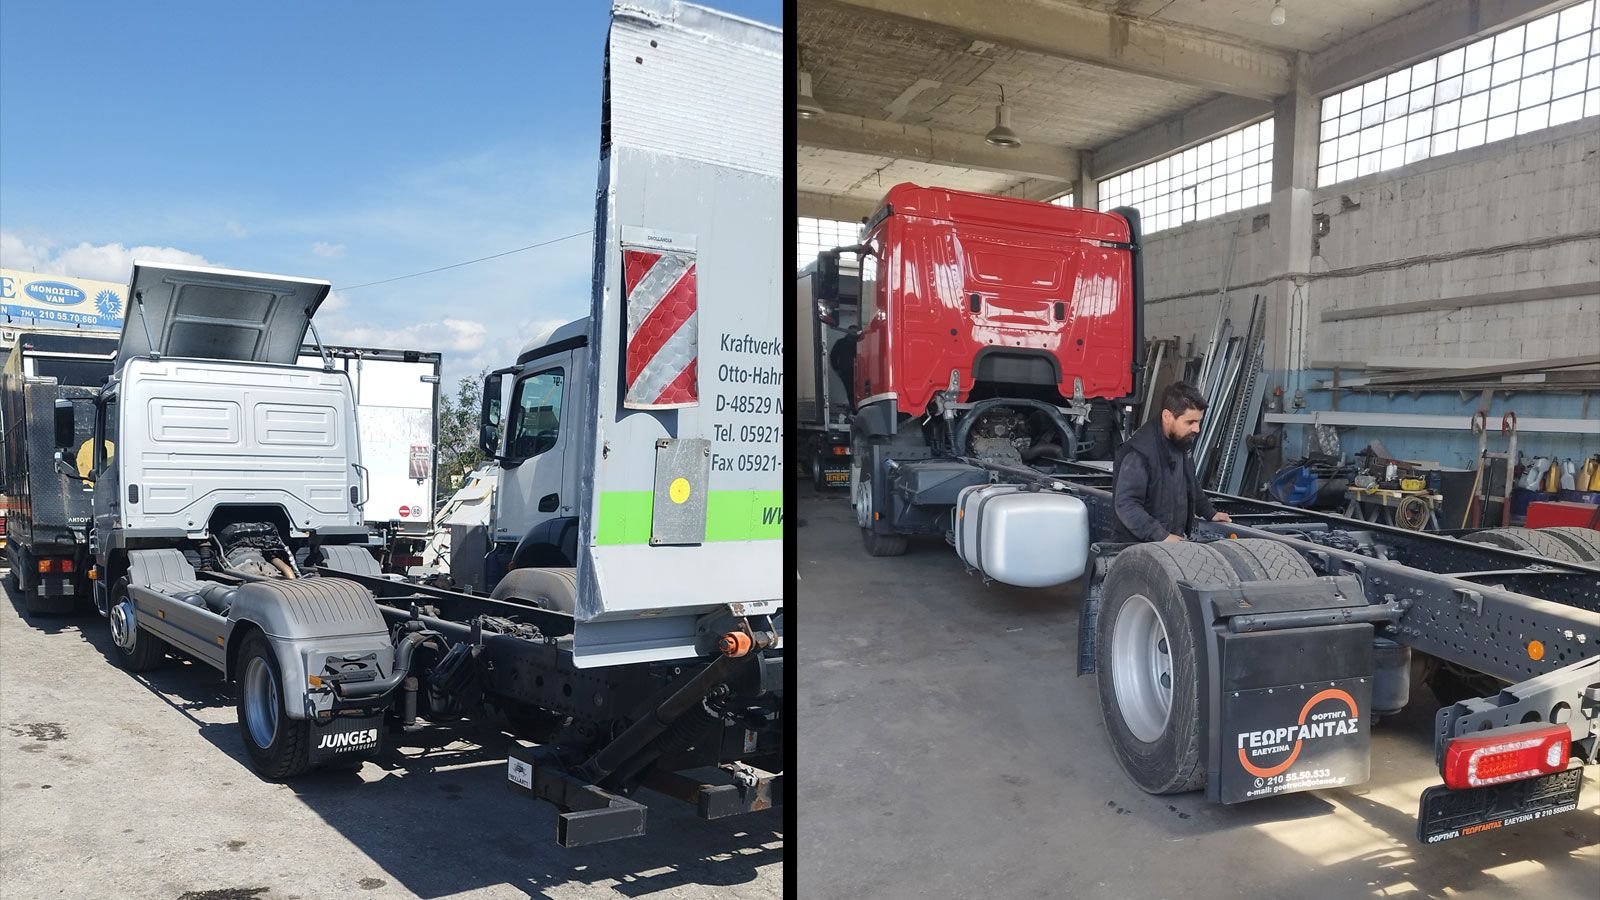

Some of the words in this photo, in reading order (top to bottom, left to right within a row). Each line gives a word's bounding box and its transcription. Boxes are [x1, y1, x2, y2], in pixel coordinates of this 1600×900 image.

[30, 284, 80, 297] ΜΟΝΩΣΕΙΣ
[45, 294, 65, 304] VAN
[39, 310, 54, 319] 210
[57, 312, 97, 325] 55.70.660
[716, 394, 772, 414] D-48529
[713, 424, 735, 442] Tel.
[711, 454, 734, 471] Fax
[738, 454, 782, 472] 05921-
[1311, 710, 1347, 721] ΦΟΡΤΗΓΑ
[1238, 718, 1358, 748] ΓΕΩΡΓΑΝΤΑΣ
[1252, 744, 1290, 757] ΕΛΕΥΣΙΝΑ
[1267, 775, 1284, 785] 210
[1285, 768, 1331, 782] 55.50.533
[1246, 786, 1272, 797] e-mail:
[1428, 830, 1460, 844] ΦΟΡΤΗΓΑ
[1461, 820, 1503, 836] ΓΕΩΡΓΑΝΤΑΣ
[1504, 813, 1534, 826] ΕΛΕΥΣΙΝΑ
[1541, 809, 1552, 817] 210
